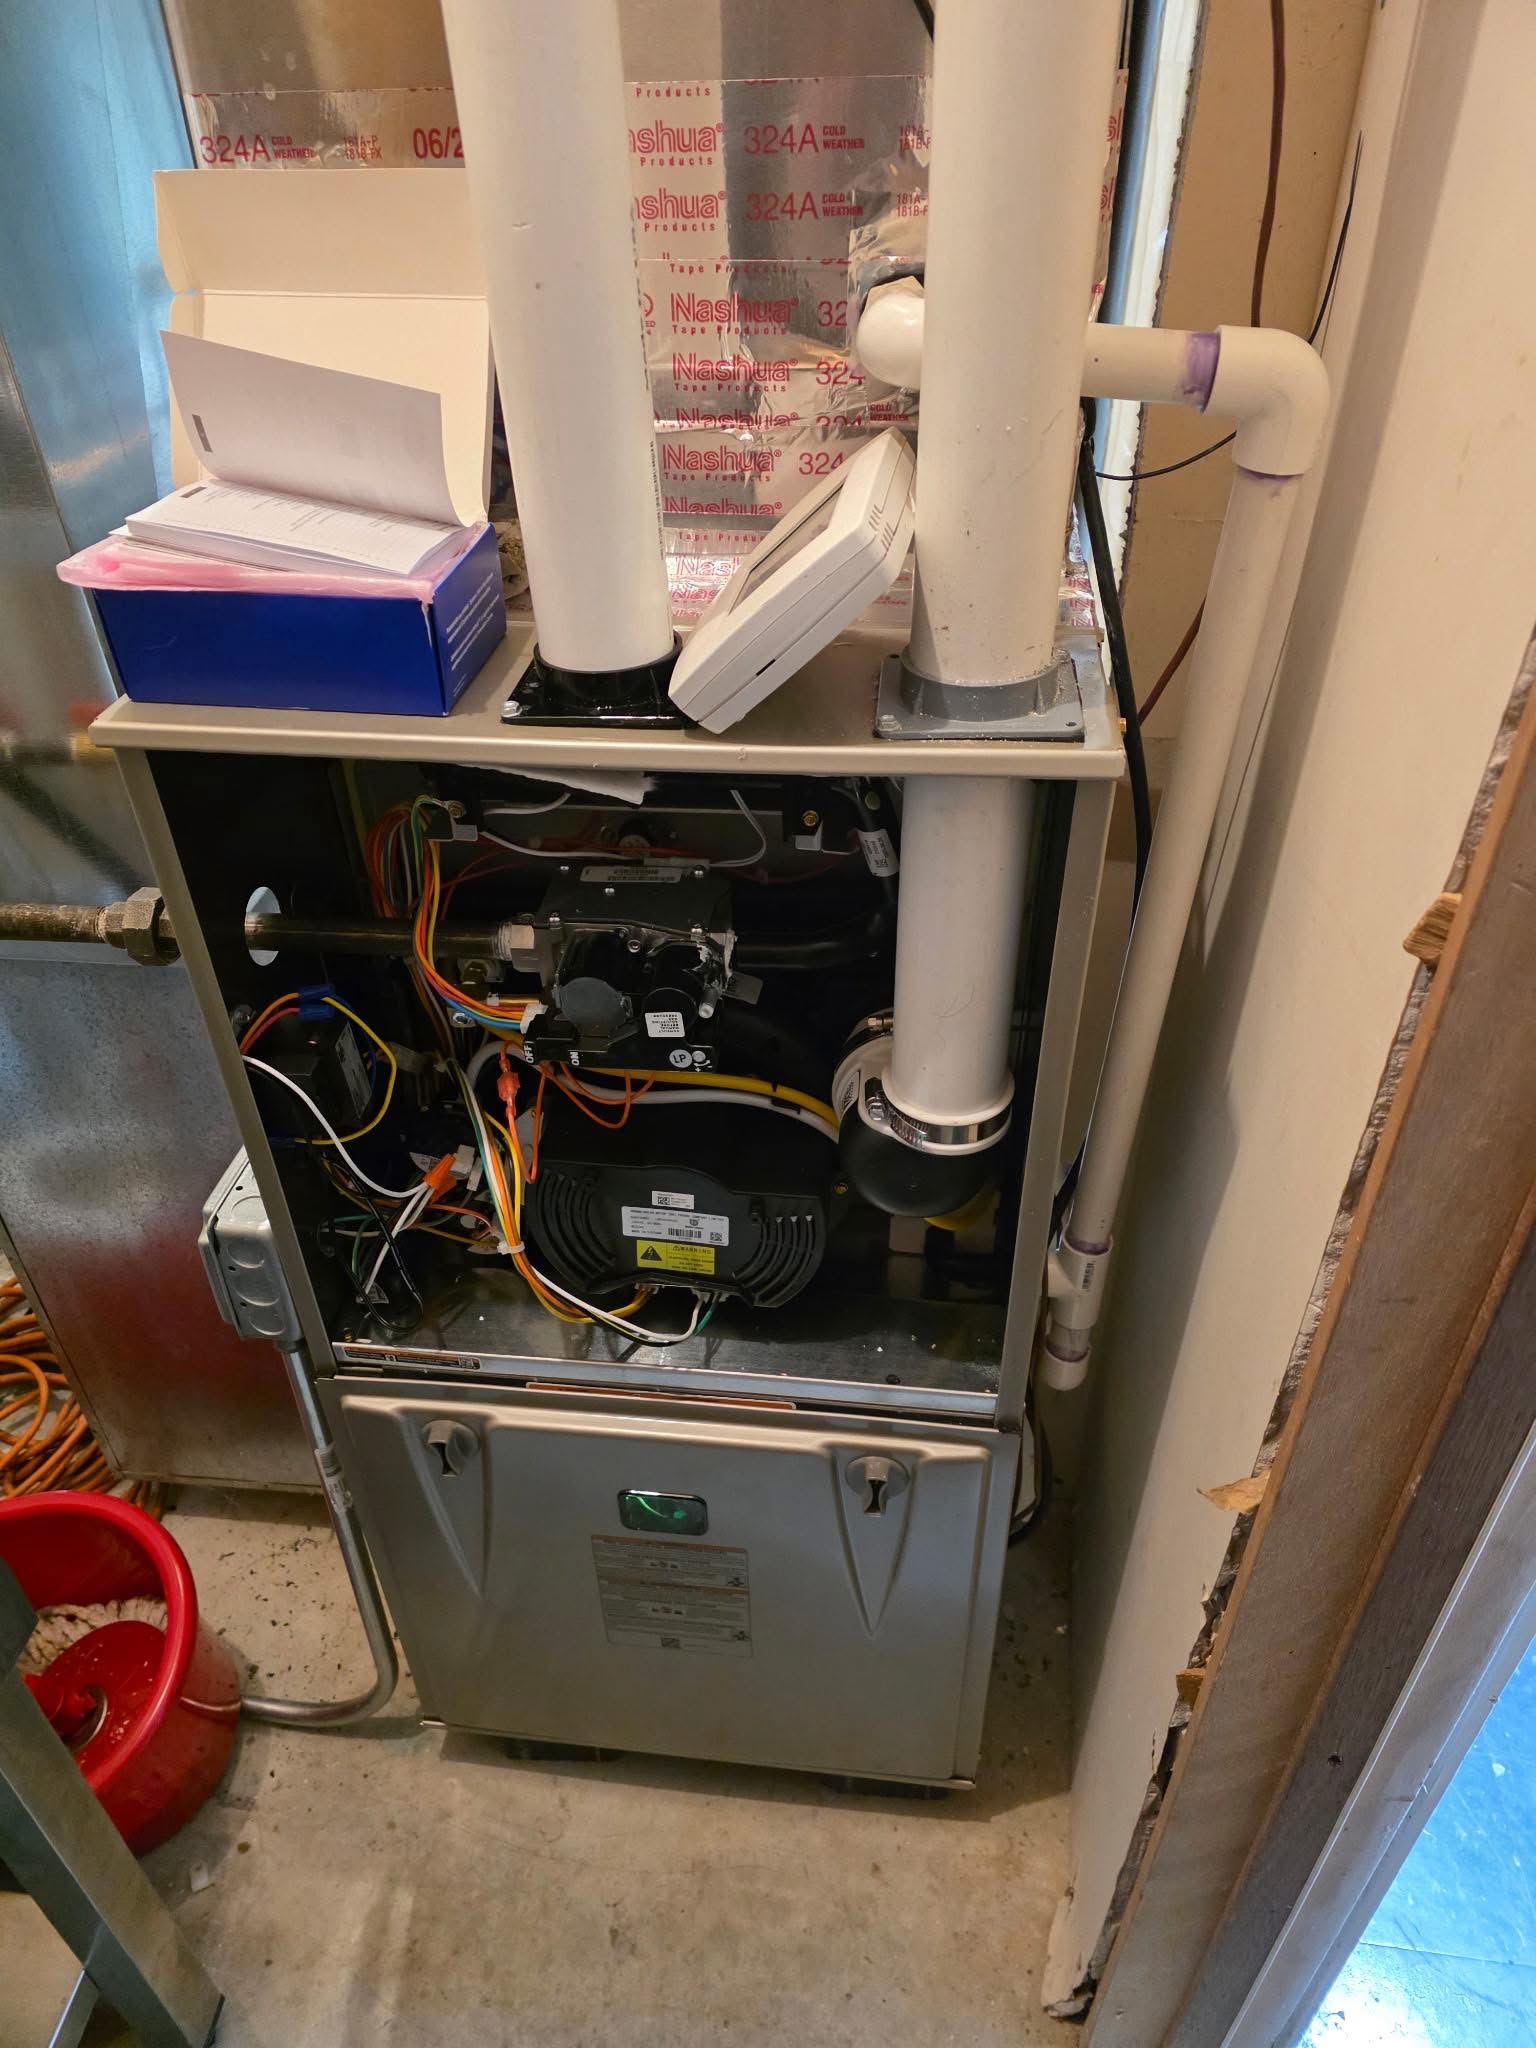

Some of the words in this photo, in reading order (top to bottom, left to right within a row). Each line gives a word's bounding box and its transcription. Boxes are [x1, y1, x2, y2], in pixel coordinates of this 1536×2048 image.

[636, 86, 711, 98] Products
[822, 125, 846, 137] COLD
[199, 133, 273, 164] 324A
[412, 126, 465, 160] 06/2
[744, 123, 819, 155] 324A
[822, 138, 865, 150] WEATHER
[640, 156, 714, 167] Products
[821, 192, 846, 204] COLD
[896, 192, 928, 205] 181A-
[746, 191, 819, 222] 324A
[896, 205, 929, 218] 181B-F
[644, 222, 716, 233] Products
[669, 263, 705, 275] Tape
[817, 300, 848, 327] 32
[672, 324, 706, 335] Tape
[815, 360, 866, 386] 324
[674, 383, 707, 393] Tape
[798, 452, 844, 476] 324
[664, 472, 696, 482] Tape
[718, 534, 766, 543] Produ
[524, 1045, 535, 1064] OFF
[570, 1051, 580, 1066] ON
[673, 1054, 687, 1063] LP
